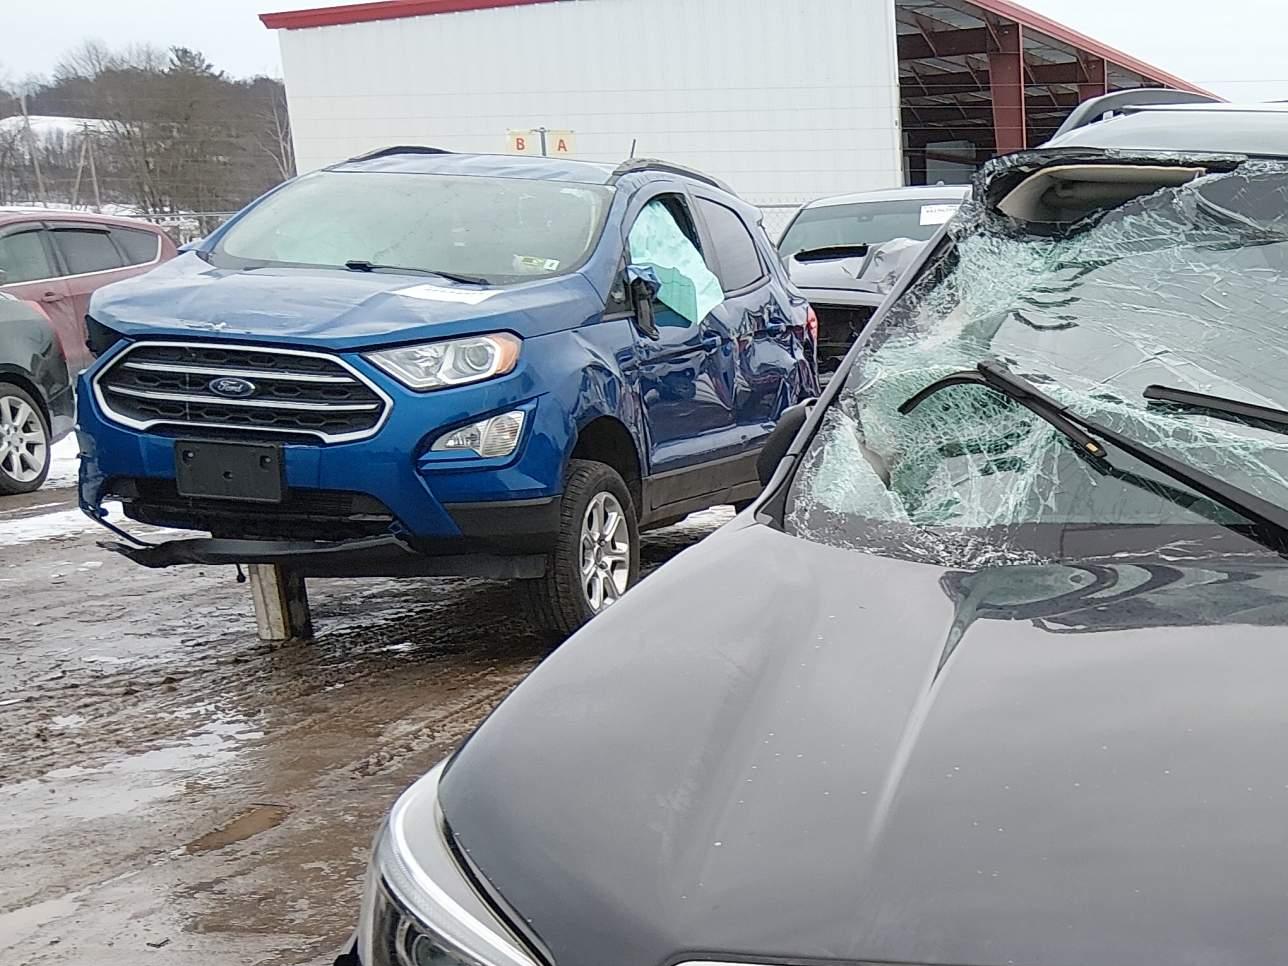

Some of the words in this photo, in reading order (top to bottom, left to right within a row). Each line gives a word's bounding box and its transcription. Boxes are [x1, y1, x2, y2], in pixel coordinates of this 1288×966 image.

[516, 137, 526, 151] B
[557, 139, 568, 152] A
[217, 380, 244, 393] Ford
